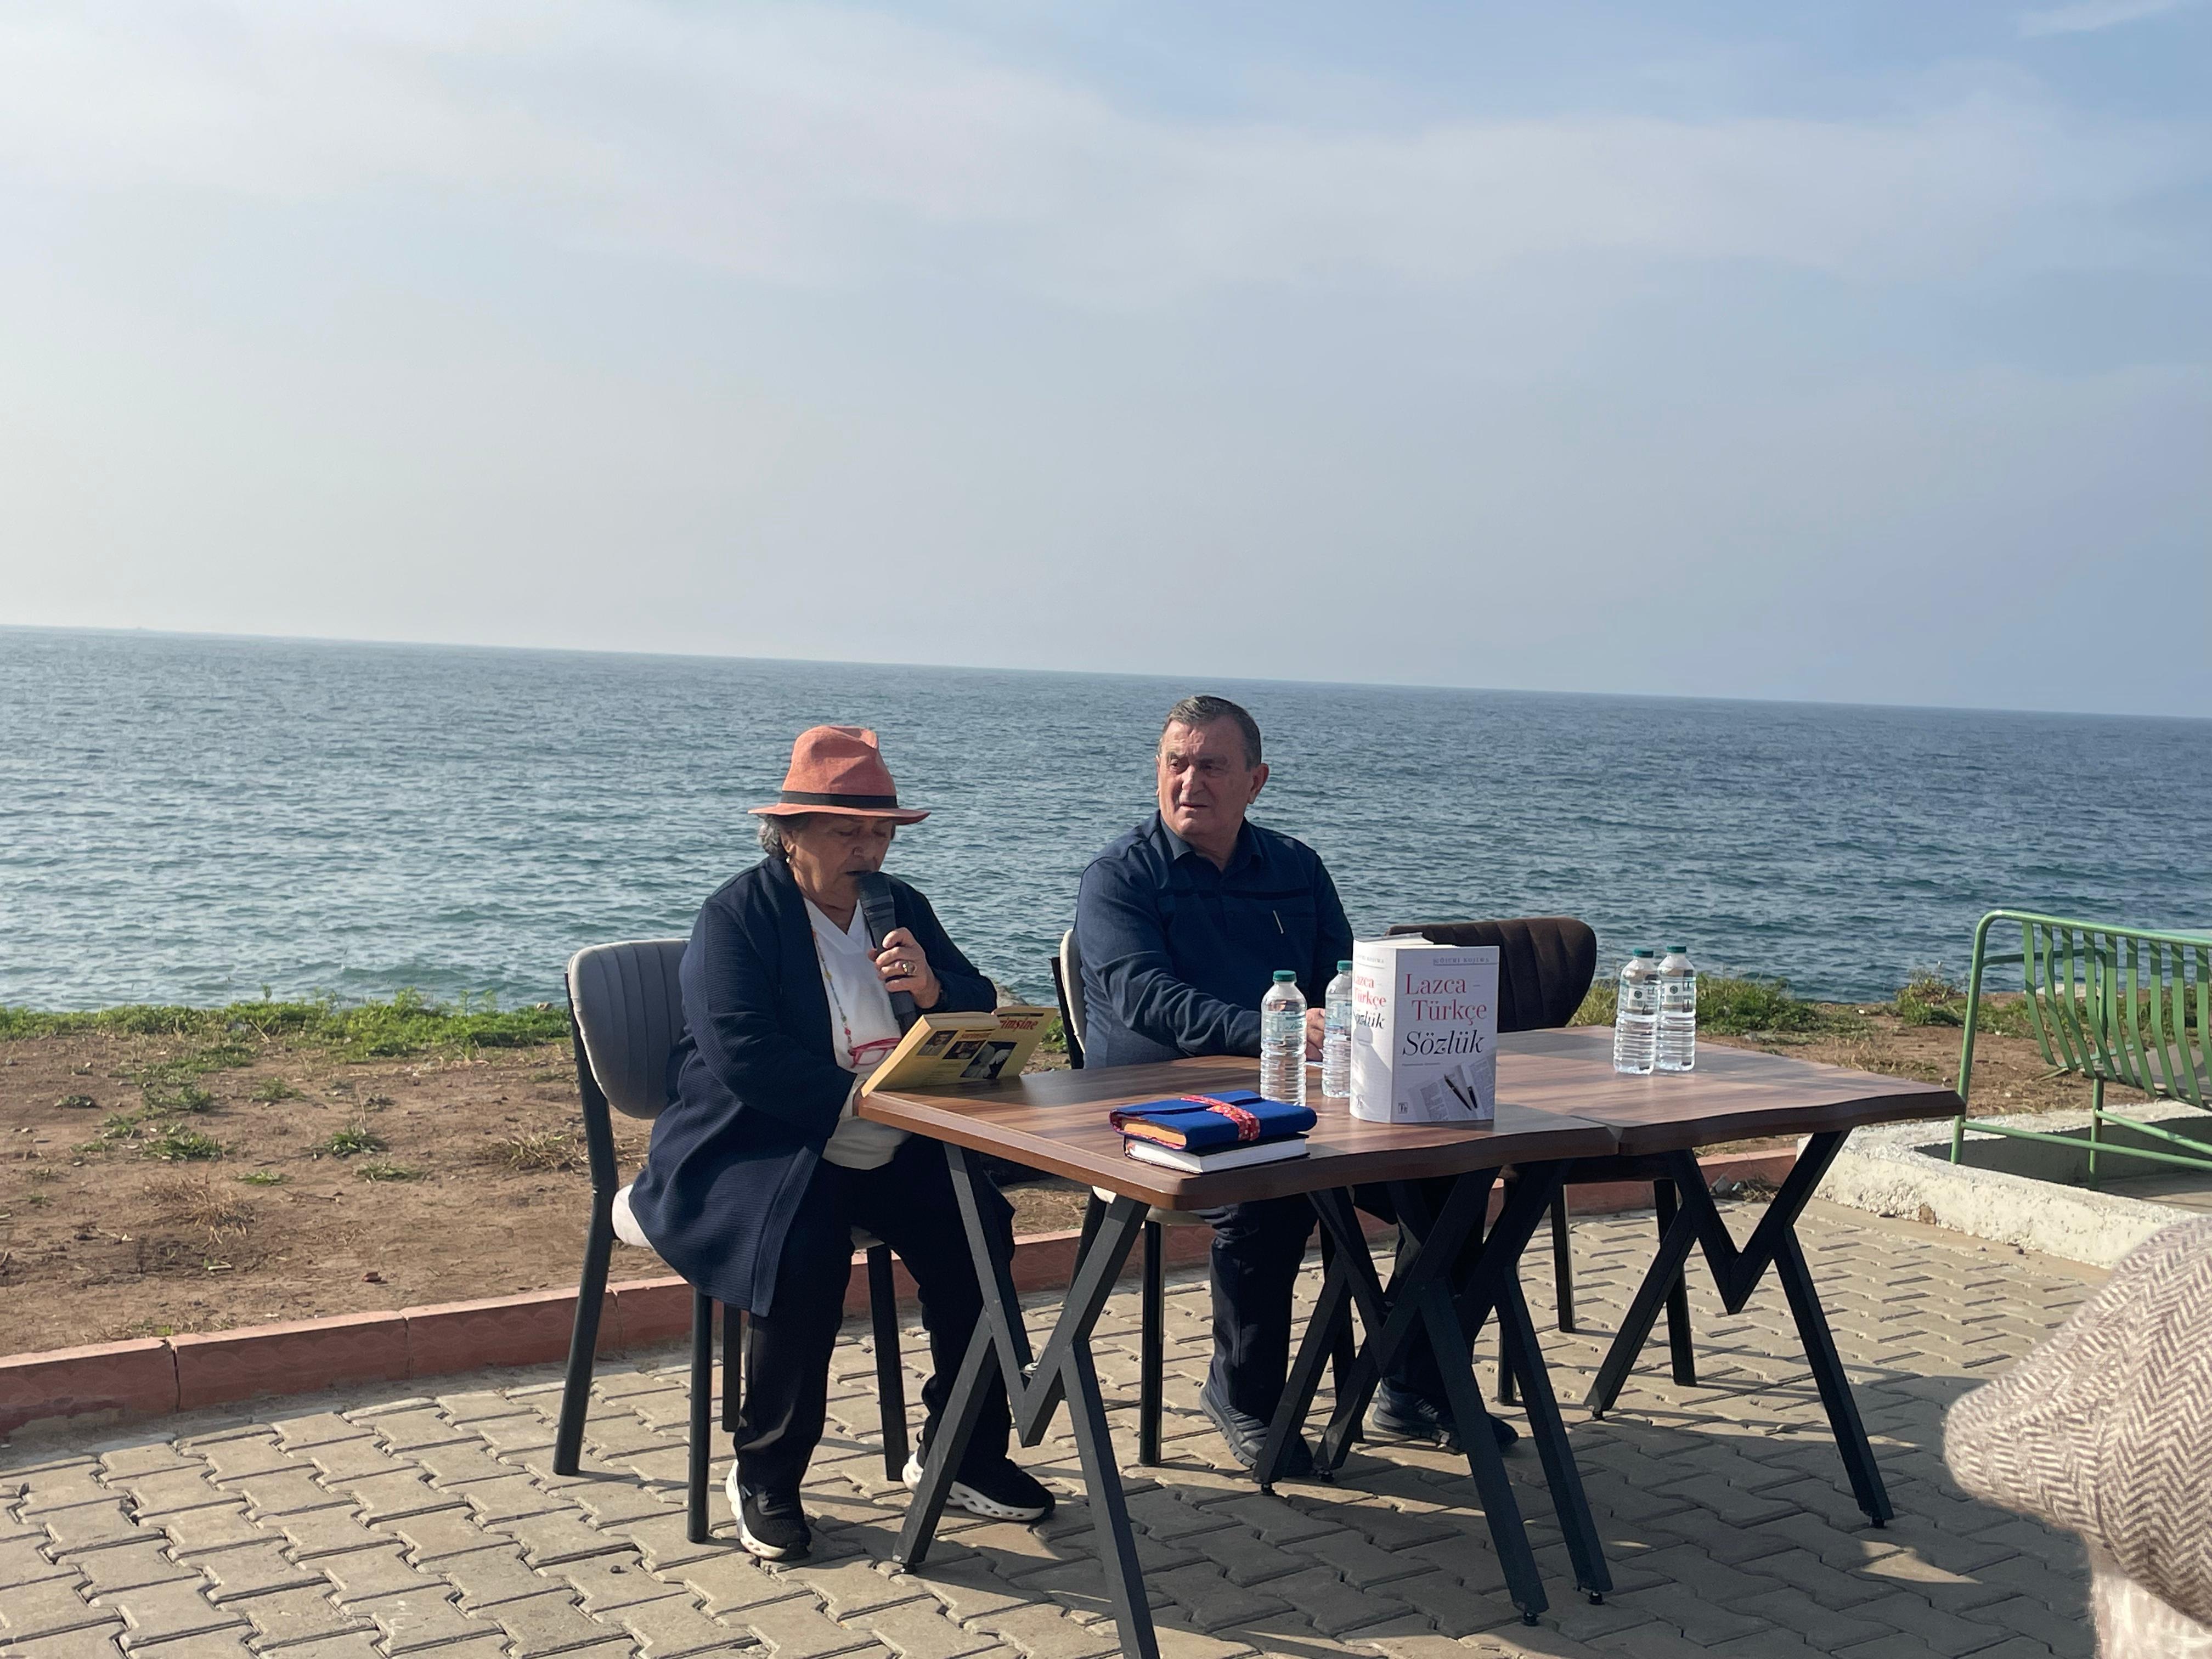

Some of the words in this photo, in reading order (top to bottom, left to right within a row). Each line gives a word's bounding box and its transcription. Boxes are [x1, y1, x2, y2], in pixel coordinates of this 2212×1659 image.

[1406, 973, 1466, 995] Lazca
[1412, 1000, 1487, 1025] Türkçe
[1402, 1030, 1485, 1056] Sözlük
